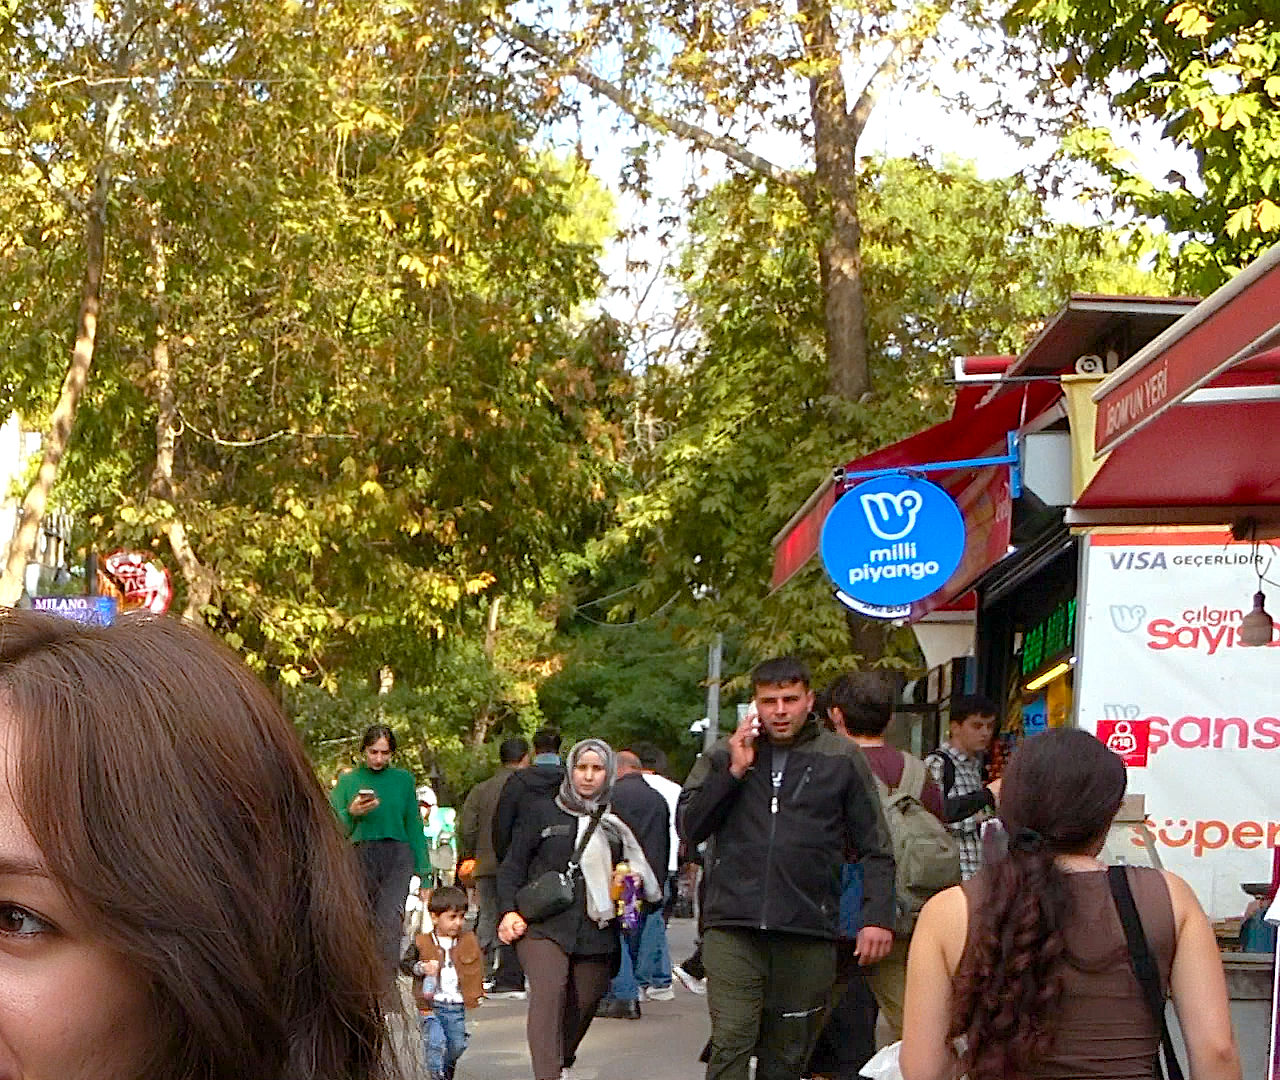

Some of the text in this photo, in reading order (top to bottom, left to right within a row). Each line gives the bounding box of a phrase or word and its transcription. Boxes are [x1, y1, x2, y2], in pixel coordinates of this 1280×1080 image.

[1144, 358, 1168, 409] YERİ
[869, 542, 917, 563] milli
[1109, 551, 1264, 570] VISA GEÇERLİDİR
[848, 560, 940, 585] piyango
[34, 598, 88, 610] MILANO
